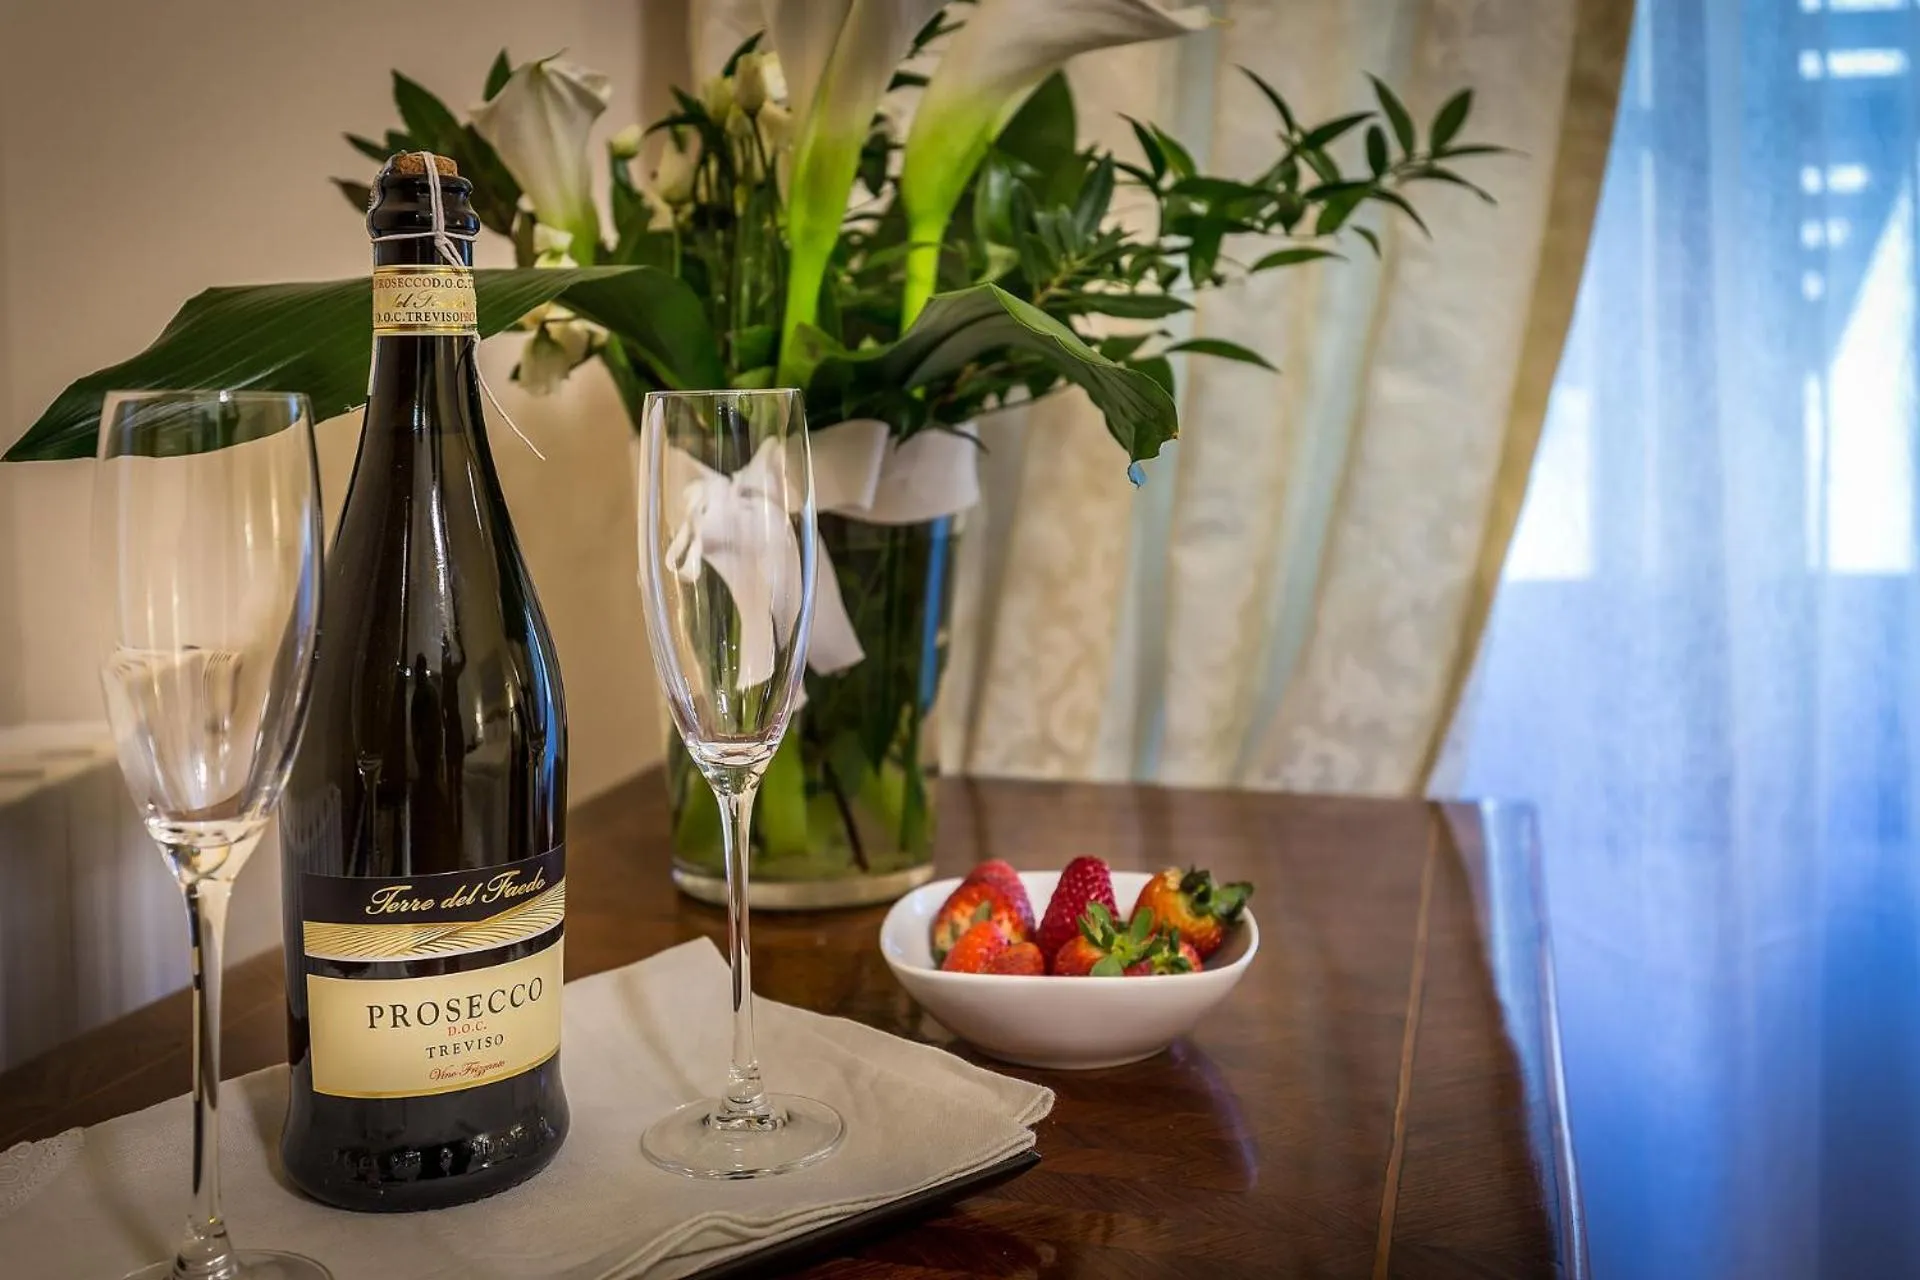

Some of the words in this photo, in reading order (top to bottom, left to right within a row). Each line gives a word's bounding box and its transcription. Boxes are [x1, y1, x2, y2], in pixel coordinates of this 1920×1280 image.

[405, 312, 460, 322] TREVISO
[365, 884, 436, 915] Terre
[439, 882, 484, 910] del
[481, 866, 546, 904] Faedo
[366, 977, 543, 1029] PROSECCO
[447, 1021, 487, 1037] D.O.C.
[425, 1033, 504, 1059] TREVISO
[429, 1065, 461, 1081] Vino
